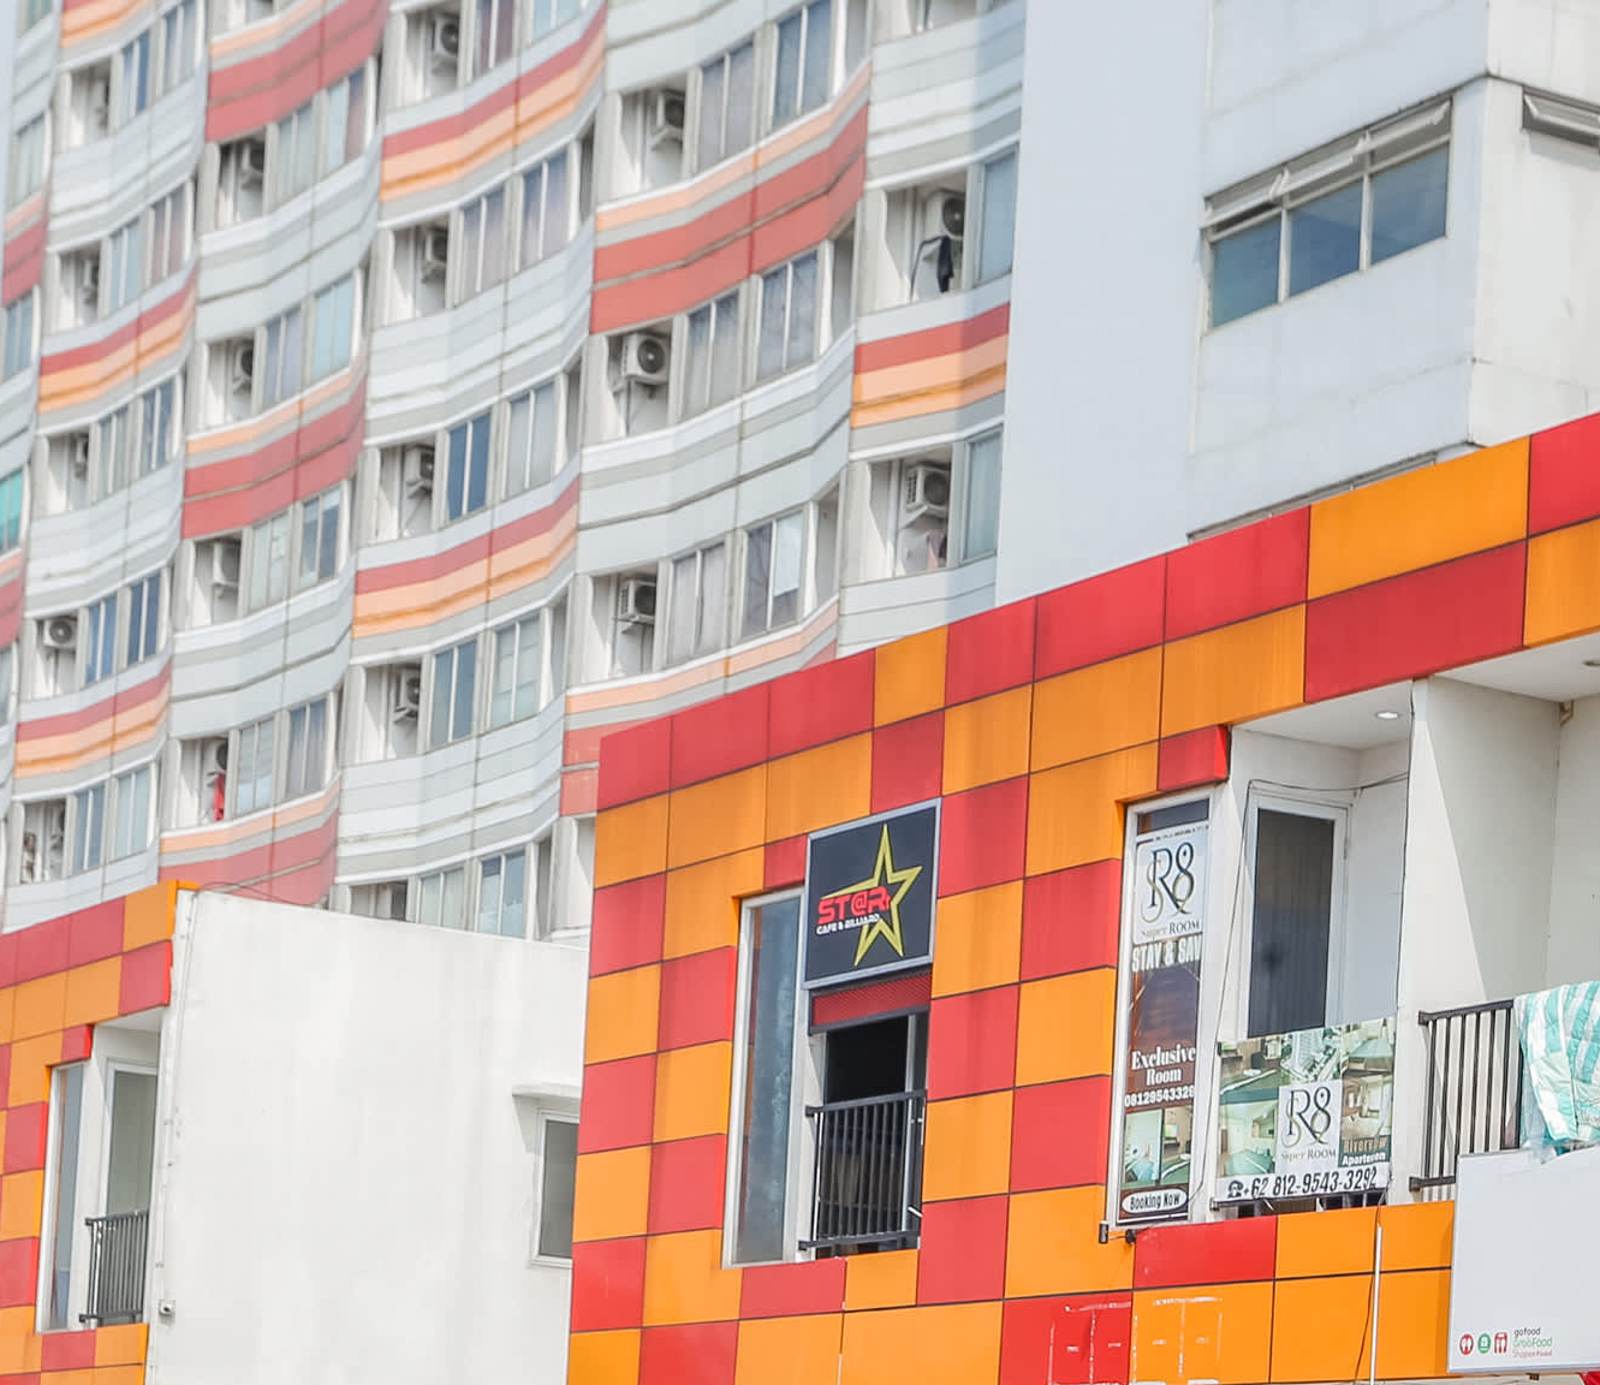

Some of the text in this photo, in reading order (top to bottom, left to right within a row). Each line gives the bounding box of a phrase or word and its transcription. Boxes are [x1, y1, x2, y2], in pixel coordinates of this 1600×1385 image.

[1169, 920, 1200, 935] ROOM
[1132, 941, 1162, 972] STAY
[1131, 1044, 1196, 1070] Exclusive
[1146, 1068, 1182, 1086] Room
[1281, 1086, 1332, 1148] R8
[1307, 1149, 1337, 1160] ROOM
[1273, 1167, 1377, 1196] 812-9543-3292
